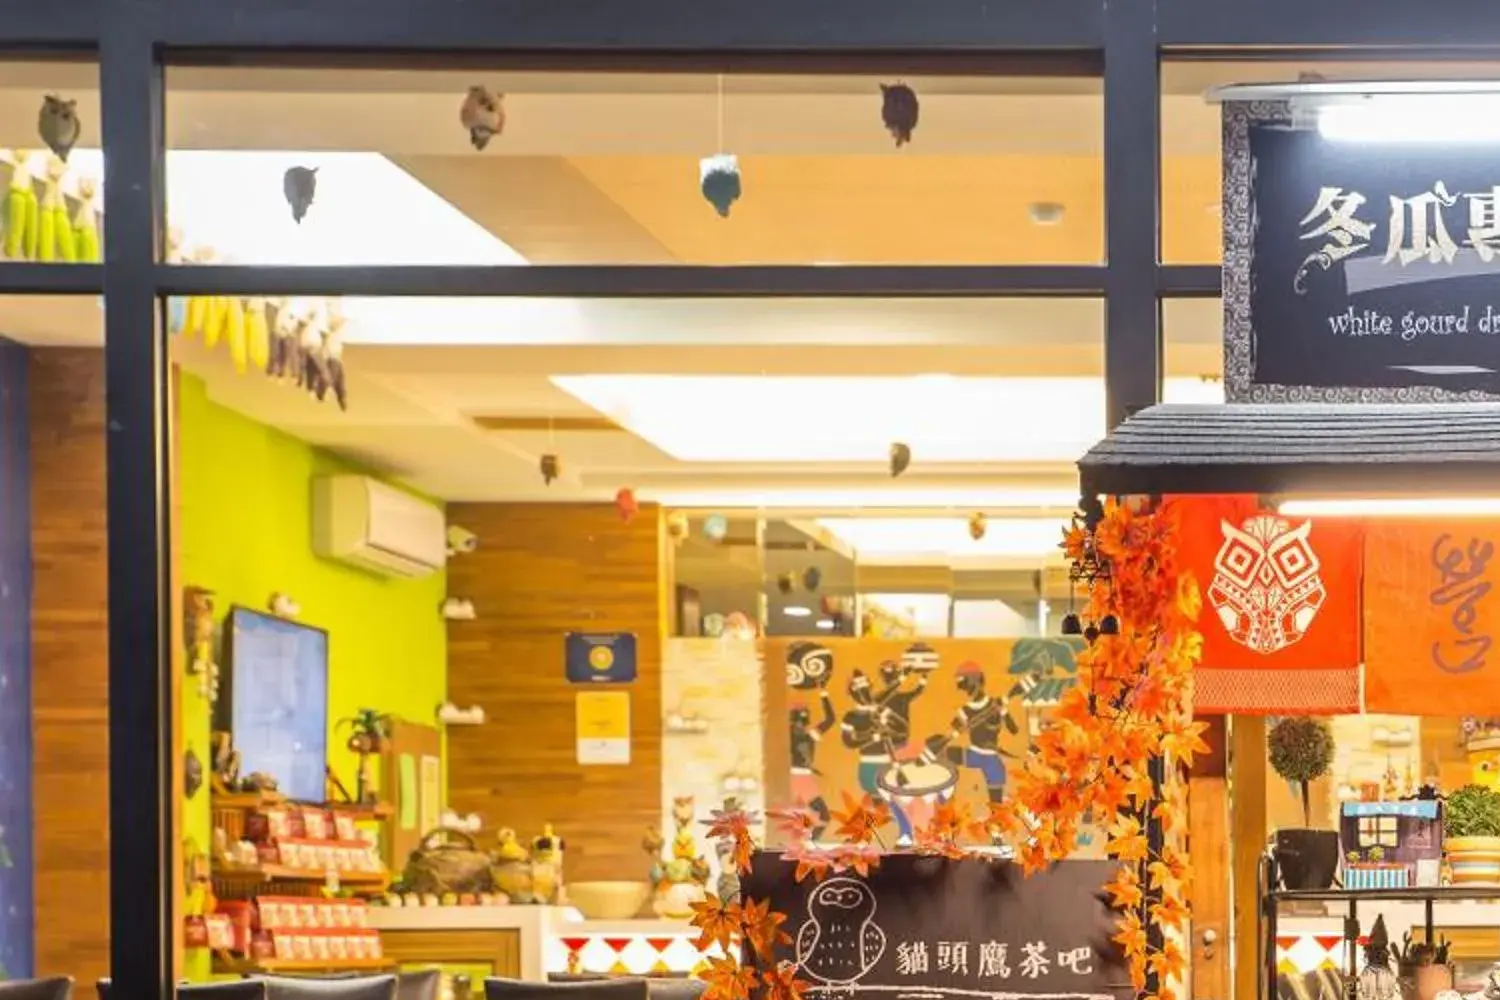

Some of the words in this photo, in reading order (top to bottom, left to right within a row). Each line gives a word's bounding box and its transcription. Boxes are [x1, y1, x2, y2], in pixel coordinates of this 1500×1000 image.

[1328, 306, 1393, 337] white
[1401, 306, 1469, 340] gourd
[895, 939, 1093, 979] 貓頭鷹茶吧
